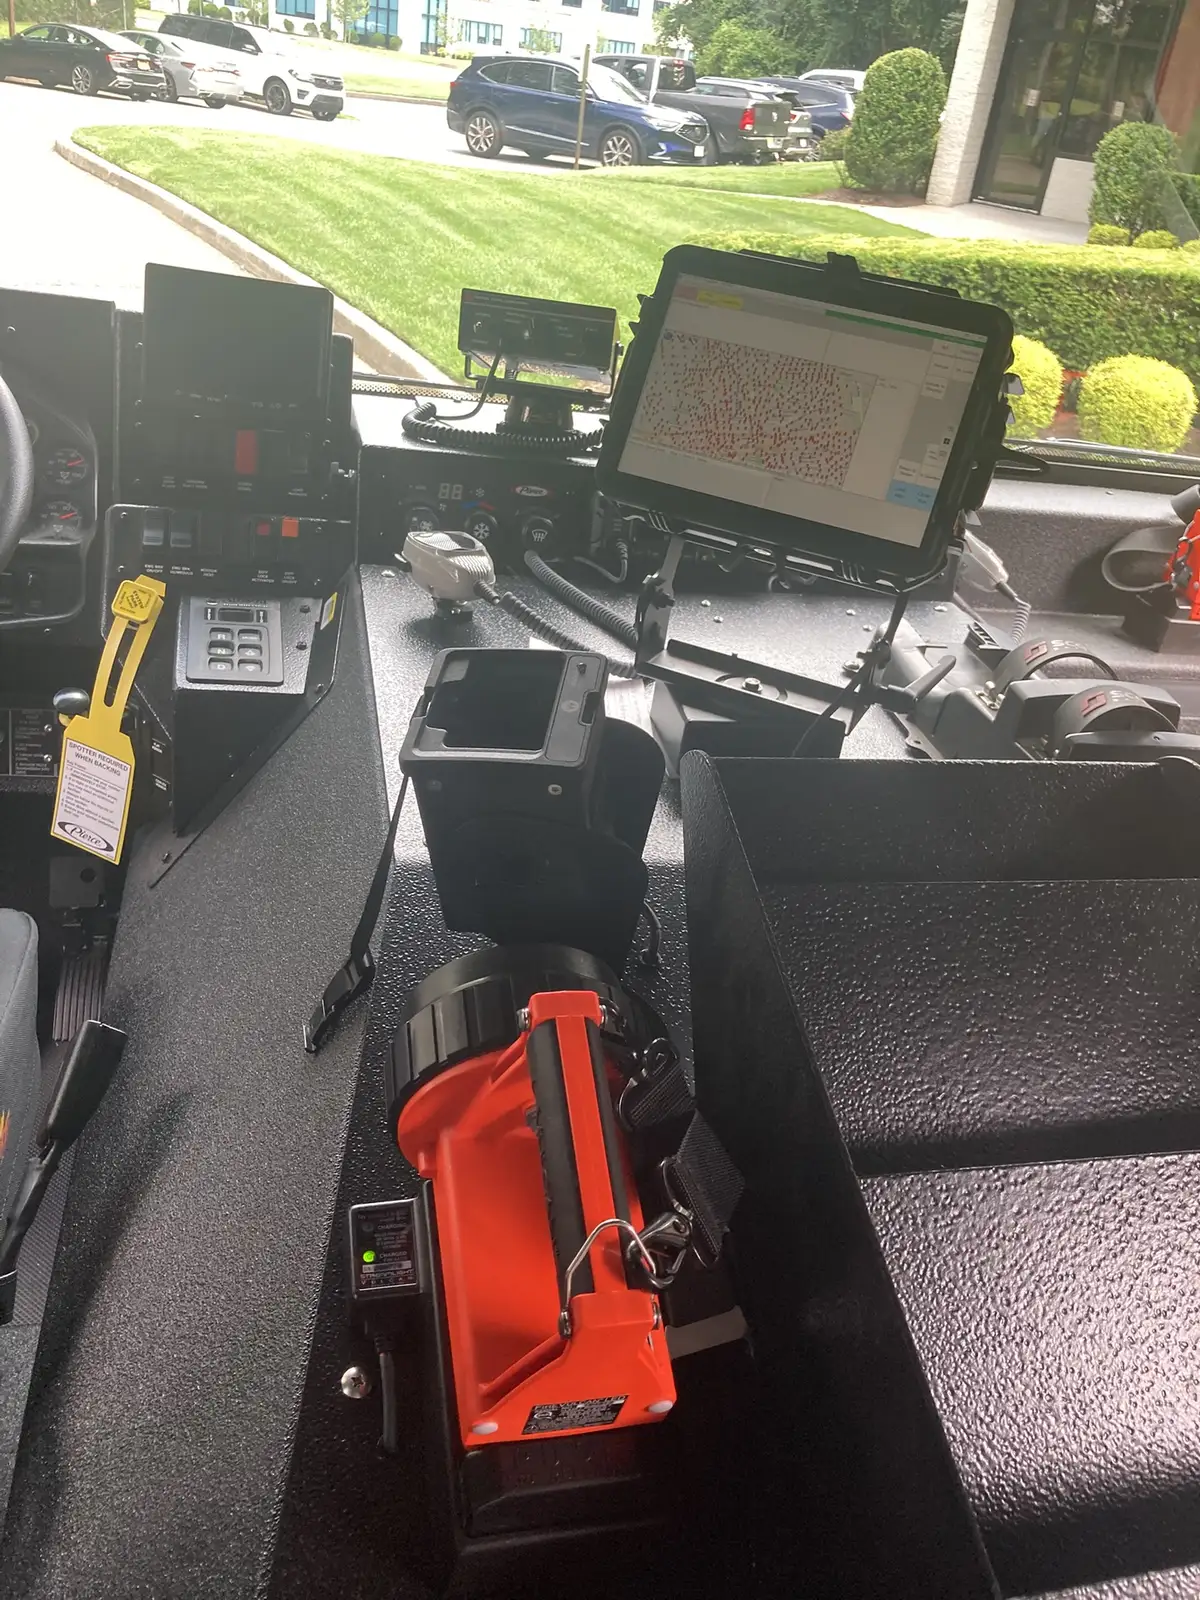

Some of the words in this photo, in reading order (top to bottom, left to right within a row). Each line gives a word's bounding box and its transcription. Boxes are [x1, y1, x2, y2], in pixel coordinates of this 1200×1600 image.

[68, 742, 98, 757] SPOTTER
[98, 750, 128, 772] REQUIRED
[75, 752, 94, 764] WHEN
[94, 760, 120, 776] BACKING
[70, 827, 101, 845] Pierce
